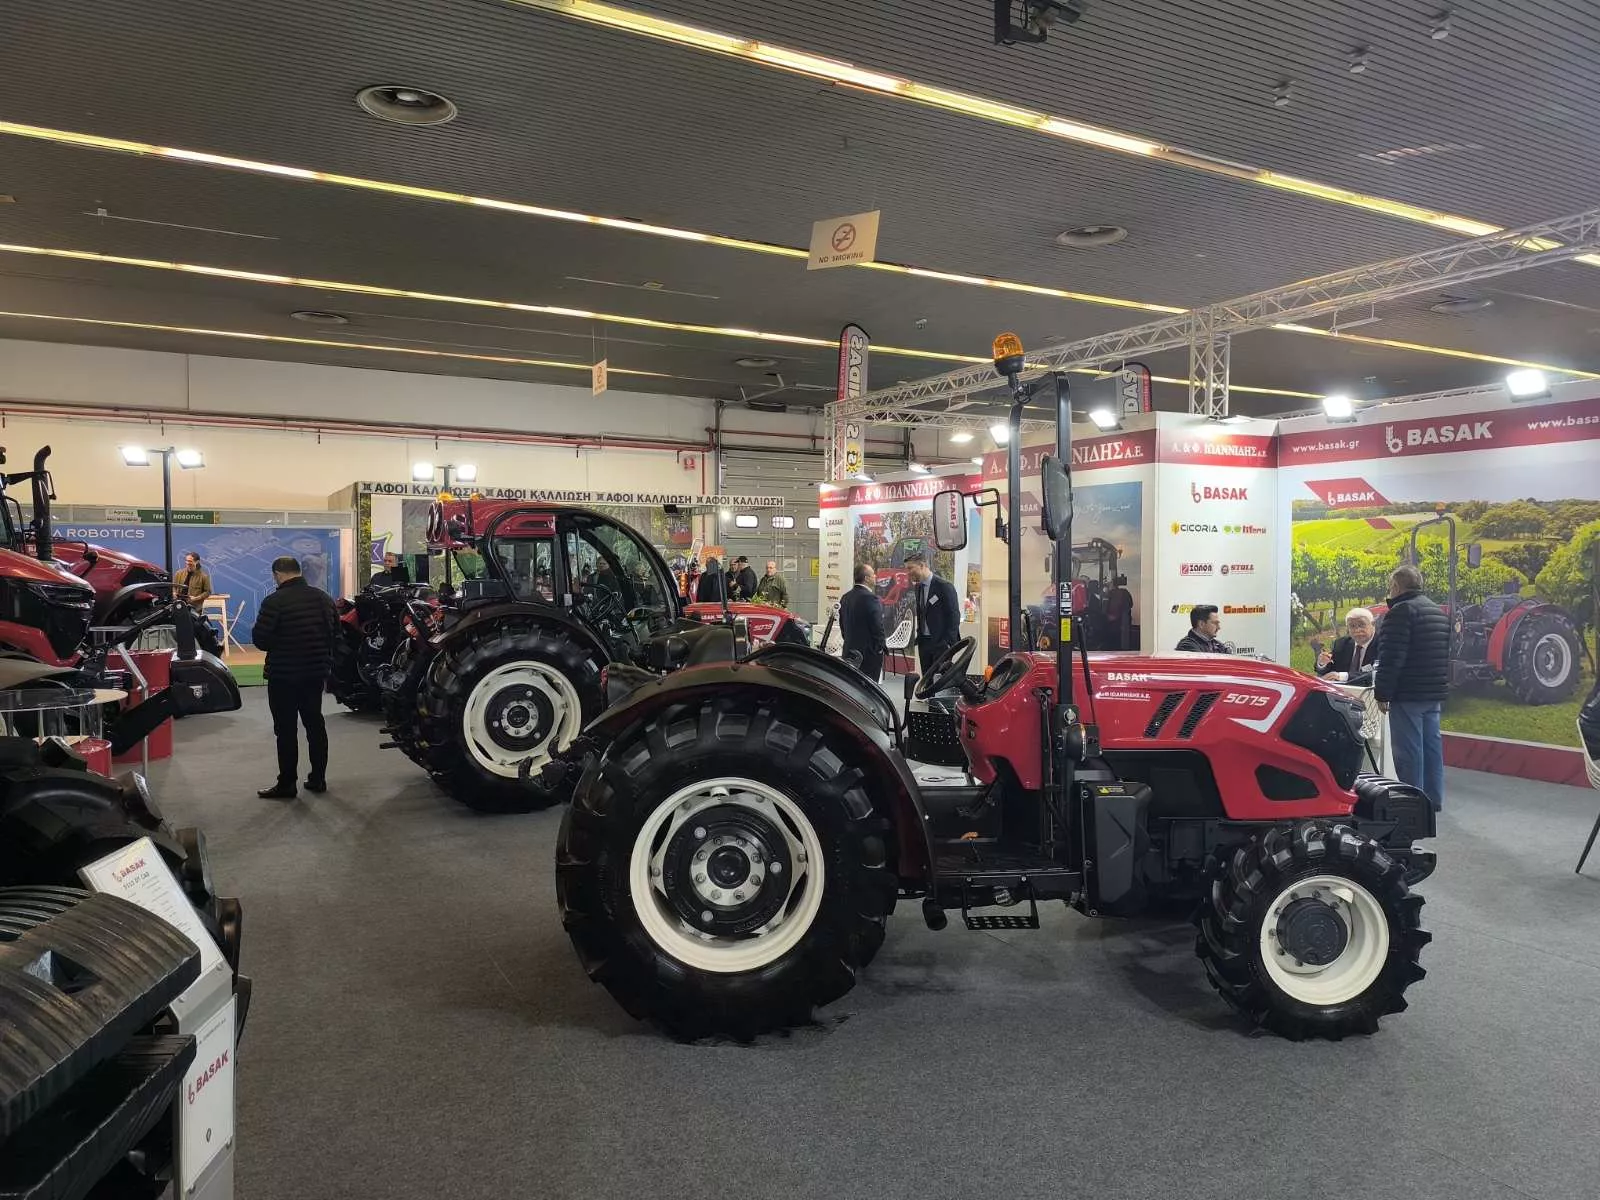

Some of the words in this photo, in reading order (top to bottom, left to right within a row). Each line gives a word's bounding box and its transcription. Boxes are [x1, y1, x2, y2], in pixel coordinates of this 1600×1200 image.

[819, 256, 829, 264] NO
[1407, 420, 1493, 447] BASAK
[1292, 439, 1360, 454] www.basak.gr
[374, 483, 408, 494] ΑΦΟΙ
[497, 488, 526, 499] ΑΦΟΙ
[530, 490, 591, 501] ΚΑΛΛΙΩΣΗ
[606, 493, 633, 503] ΑΦΟΙ
[637, 494, 692, 504] ΚΑΛΛΙΩΣΗ
[705, 496, 730, 505] ΑΦΟΙ
[733, 497, 784, 506] ΚΑΛΛΙΩΣΗ
[1203, 486, 1248, 500] BASAK
[1336, 491, 1376, 503] BASAK
[1020, 503, 1038, 512] ASAK
[66, 528, 145, 538] ROBOTICS
[1180, 524, 1218, 533] CICORIA
[1107, 672, 1149, 682] BASAK
[1223, 692, 1270, 706] 5075
[196, 1049, 229, 1094] BASAK
